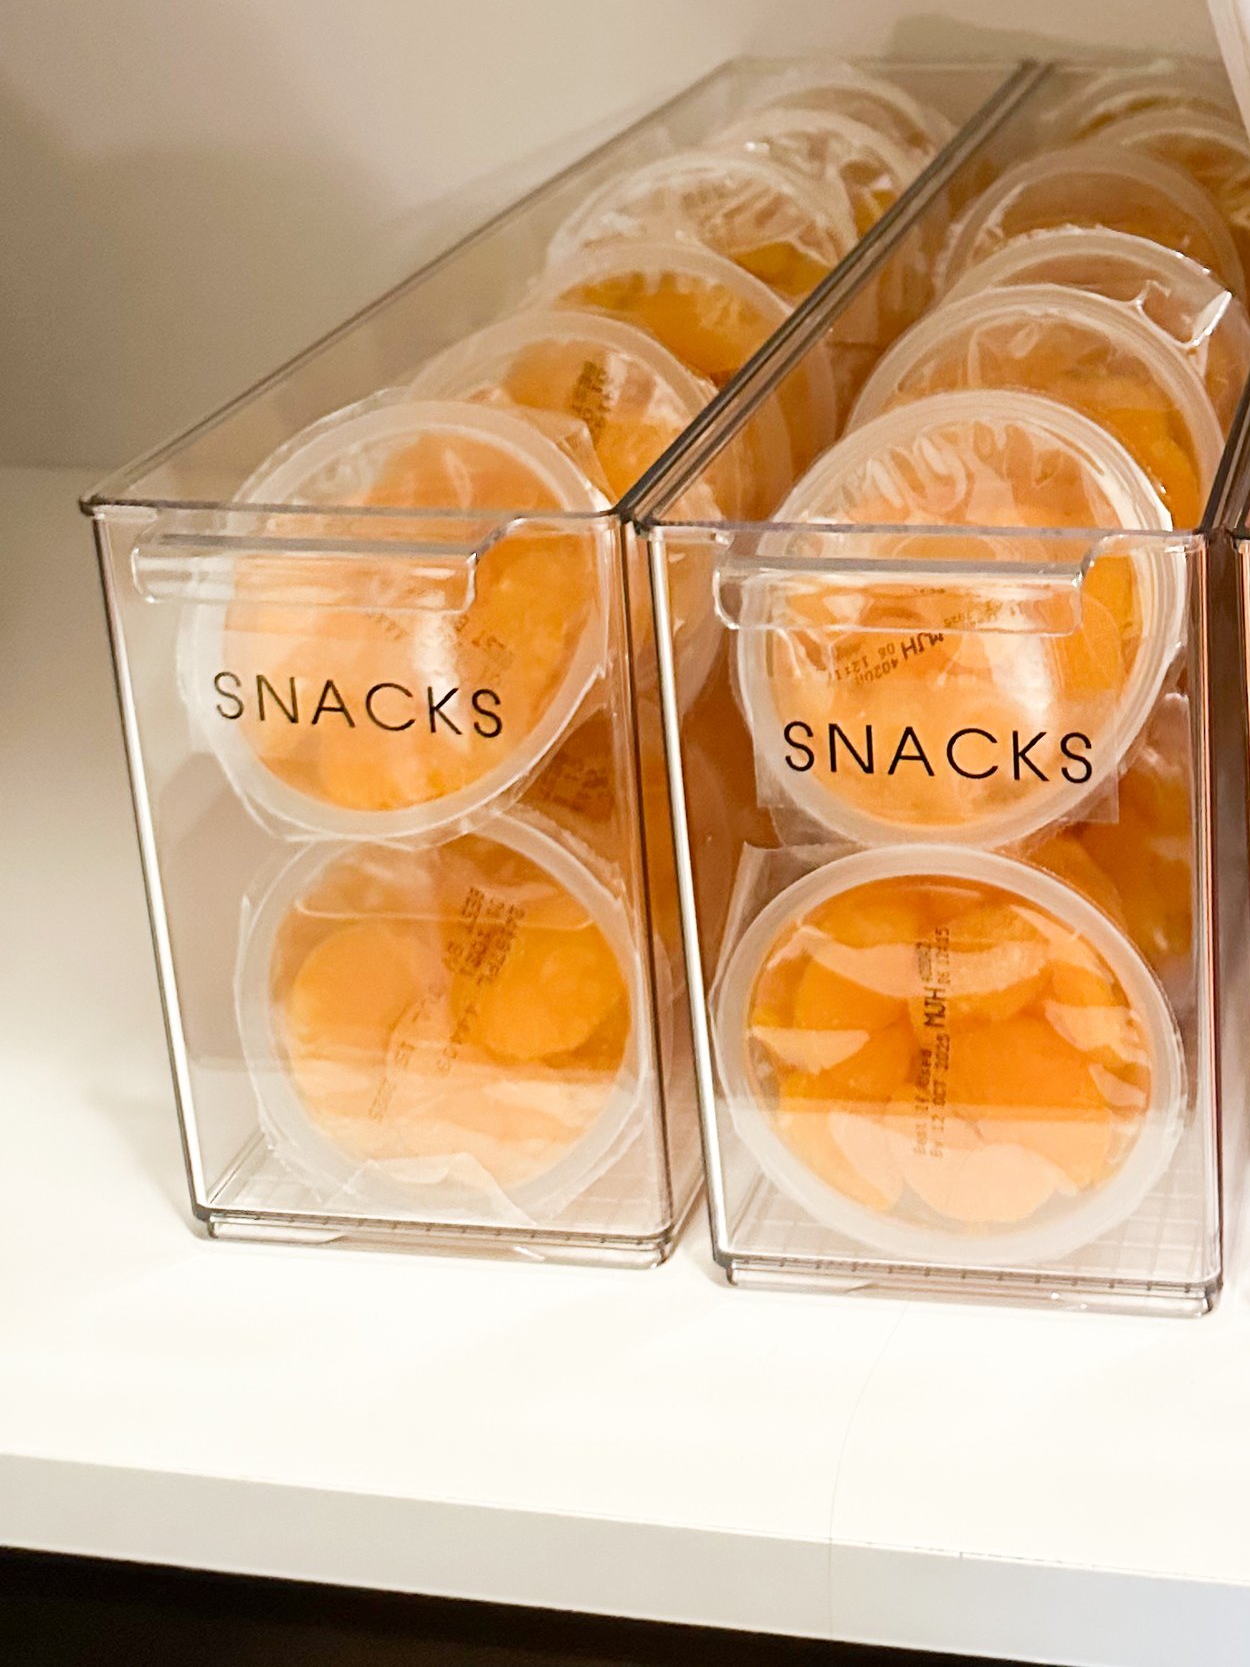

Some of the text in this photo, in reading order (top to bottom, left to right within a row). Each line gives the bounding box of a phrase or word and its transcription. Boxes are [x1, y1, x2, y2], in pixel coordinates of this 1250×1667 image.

[213, 670, 504, 739] SNACKS
[783, 720, 1093, 784] SNACKS
[924, 986, 946, 1027] MJH
